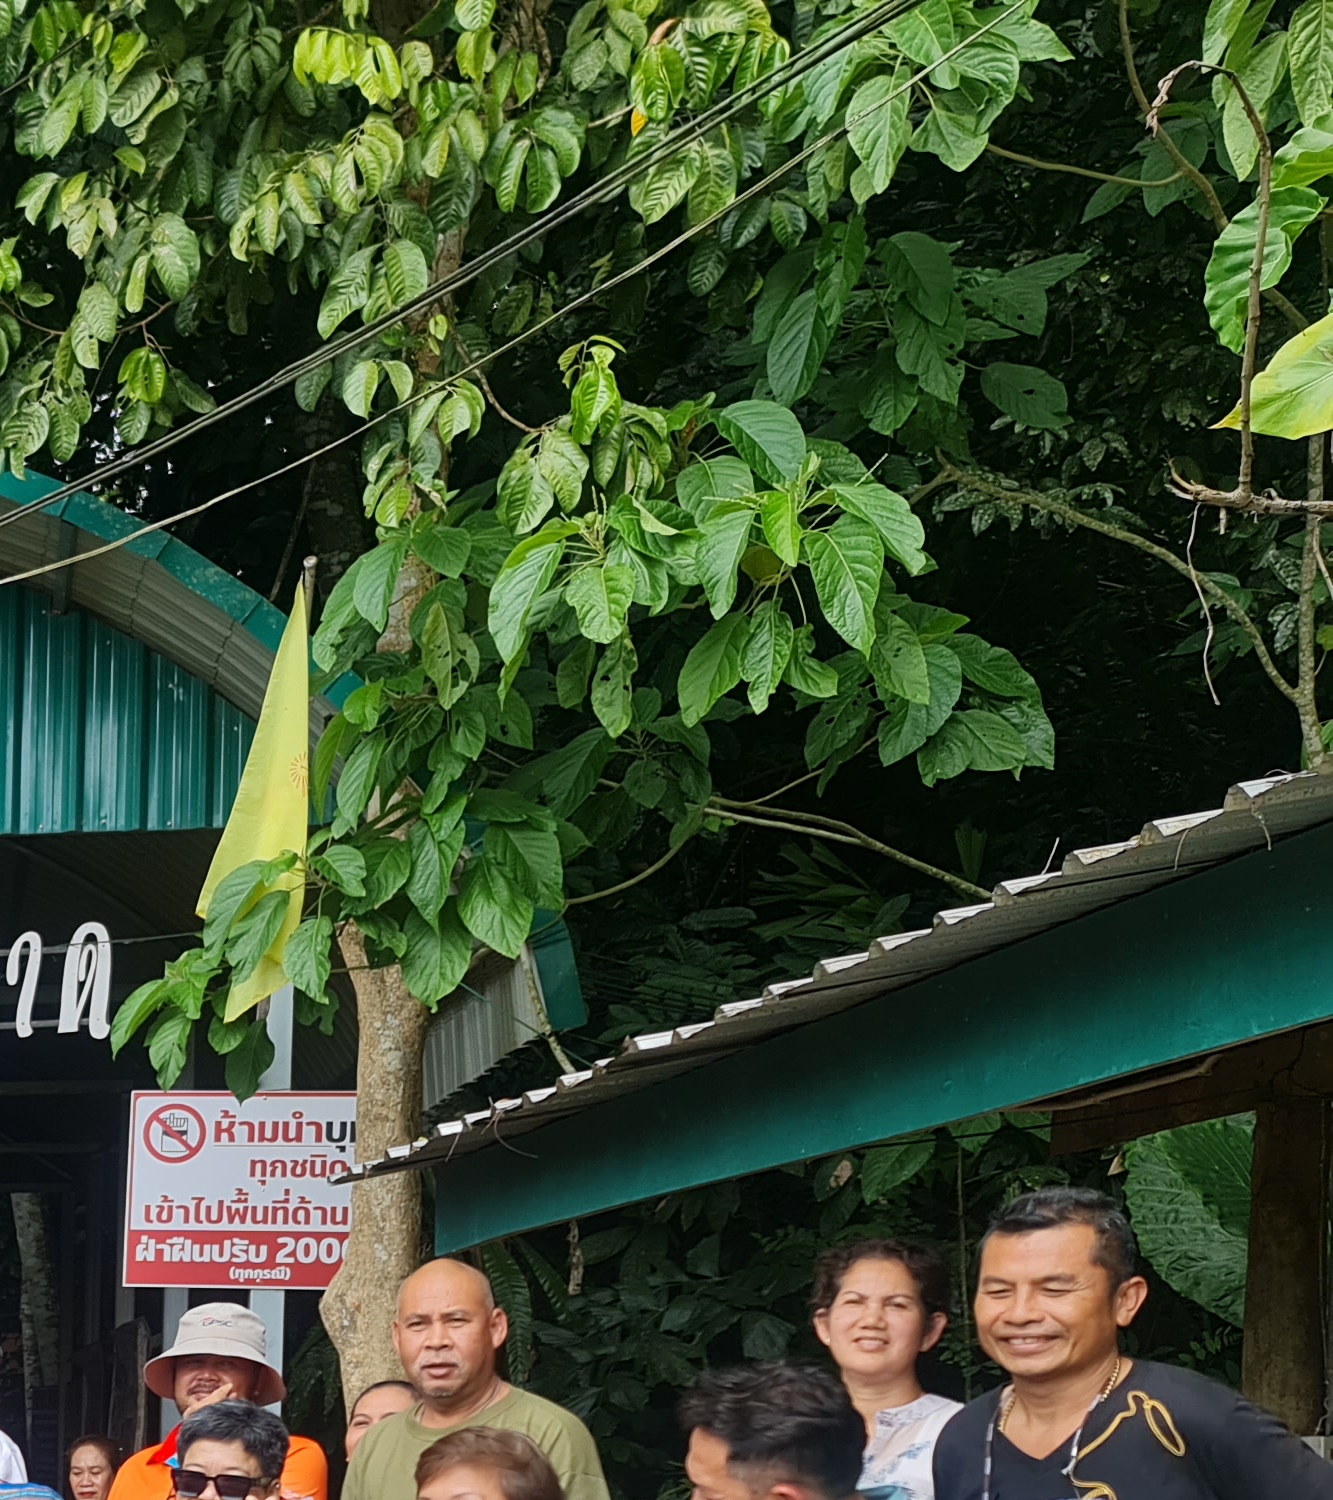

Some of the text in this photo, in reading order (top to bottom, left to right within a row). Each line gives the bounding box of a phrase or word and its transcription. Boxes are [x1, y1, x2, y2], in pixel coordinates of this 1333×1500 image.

[214, 1110, 356, 1152] ห้ามนำบุ
[136, 1235, 267, 1264] ฝ่าฝืนปรับ
